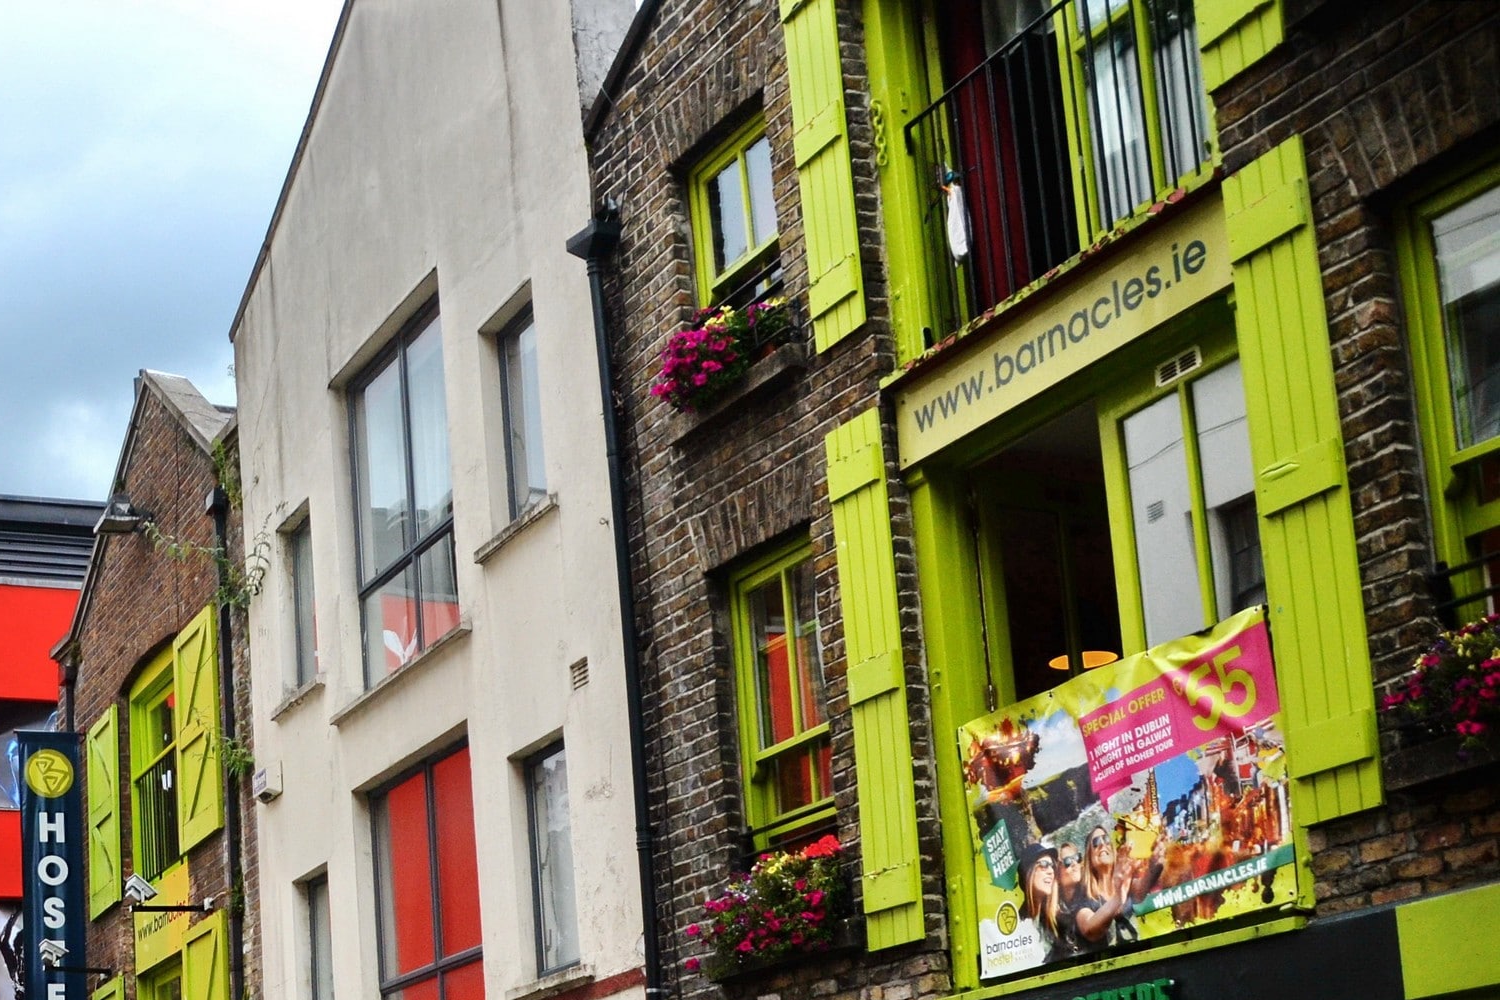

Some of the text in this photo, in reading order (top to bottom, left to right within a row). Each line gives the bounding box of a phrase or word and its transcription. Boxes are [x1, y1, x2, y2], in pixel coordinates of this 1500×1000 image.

[914, 239, 1207, 433] www.barnacles.ie
[1082, 687, 1166, 738] SPECIAL OFFER
[1094, 736, 1120, 758] NIGHT
[1121, 730, 1133, 744] IN
[1135, 713, 1170, 738] DUBLIN
[1100, 748, 1122, 767] NIGHT
[1124, 742, 1135, 755] IN
[1136, 725, 1172, 750] GALWAY
[1115, 760, 1125, 771] OF
[1125, 748, 1155, 767] MOHER
[1155, 738, 1174, 754] TOUR
[986, 826, 1005, 853] STAY
[989, 838, 1011, 864] RIGHT
[992, 854, 1015, 879] HERE
[1152, 857, 1268, 909] WWW.BARNACLES.IE
[986, 935, 1033, 955] barnacles
